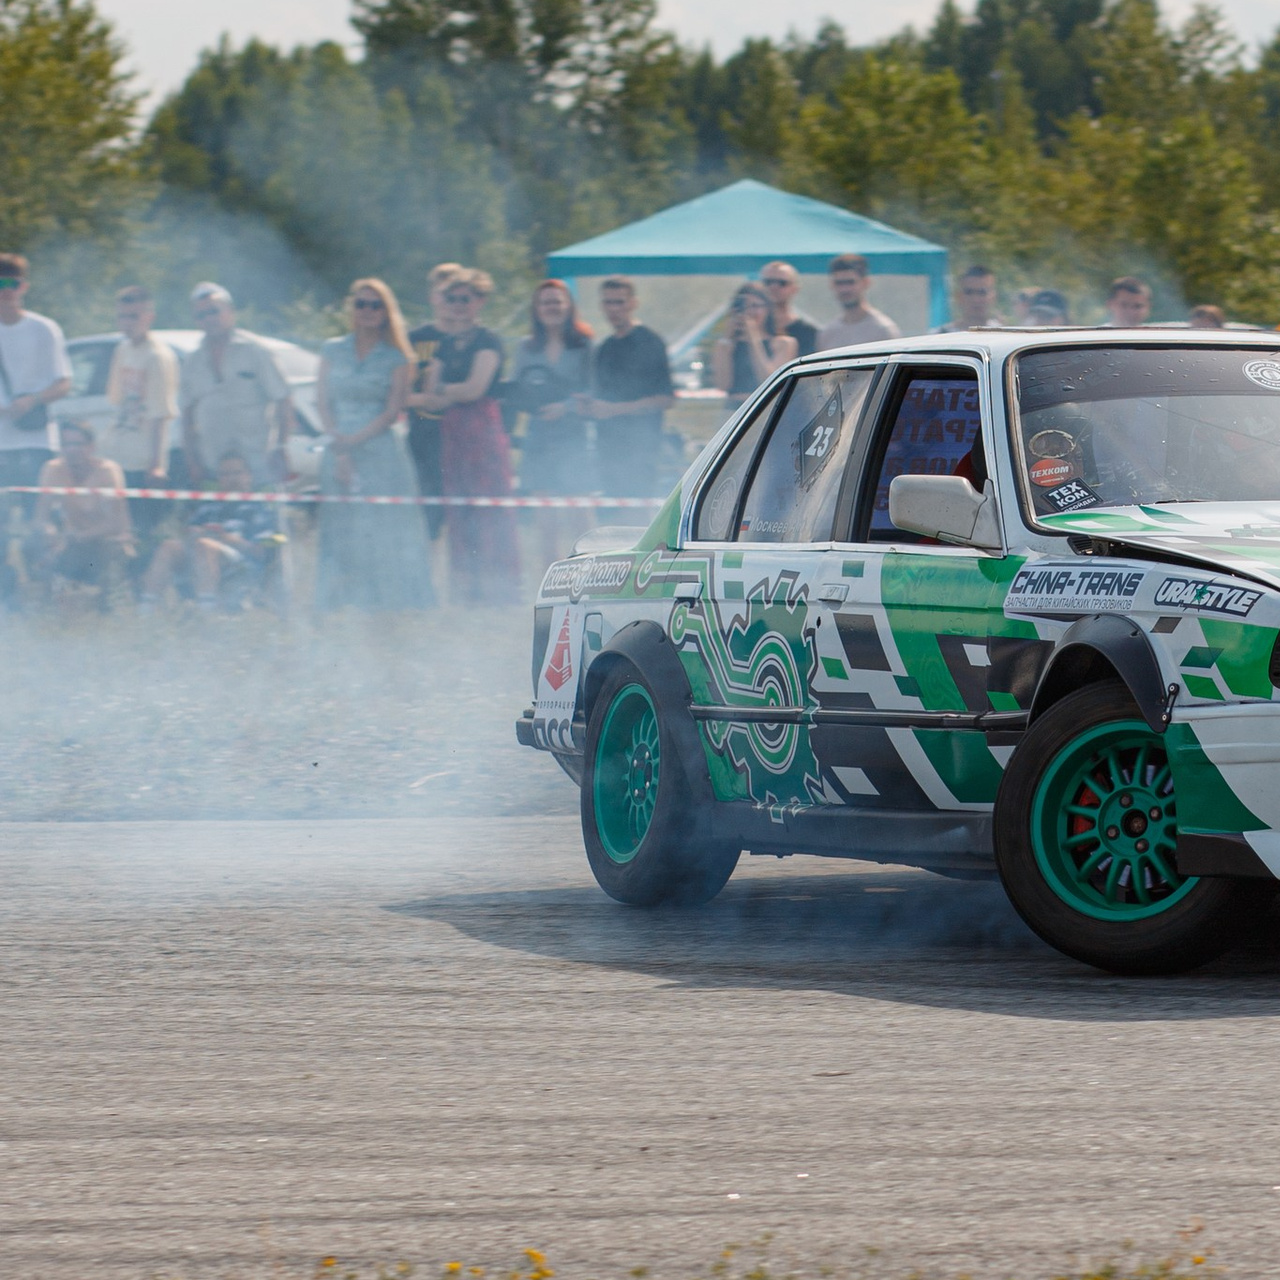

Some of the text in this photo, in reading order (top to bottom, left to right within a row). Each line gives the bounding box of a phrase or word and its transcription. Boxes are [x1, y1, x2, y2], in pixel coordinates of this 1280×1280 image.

[805, 425, 834, 458] 23
[1031, 465, 1069, 479] ТЕХКОМ
[1048, 482, 1082, 500] ТЕХ
[1056, 489, 1089, 507] КОМ
[1010, 570, 1145, 596] CHINA-TRANS
[1004, 596, 1133, 610] ЗАПЧАСТИ ДЛЯ КИТАЙСКИХ ГРУЗОВИКОВ
